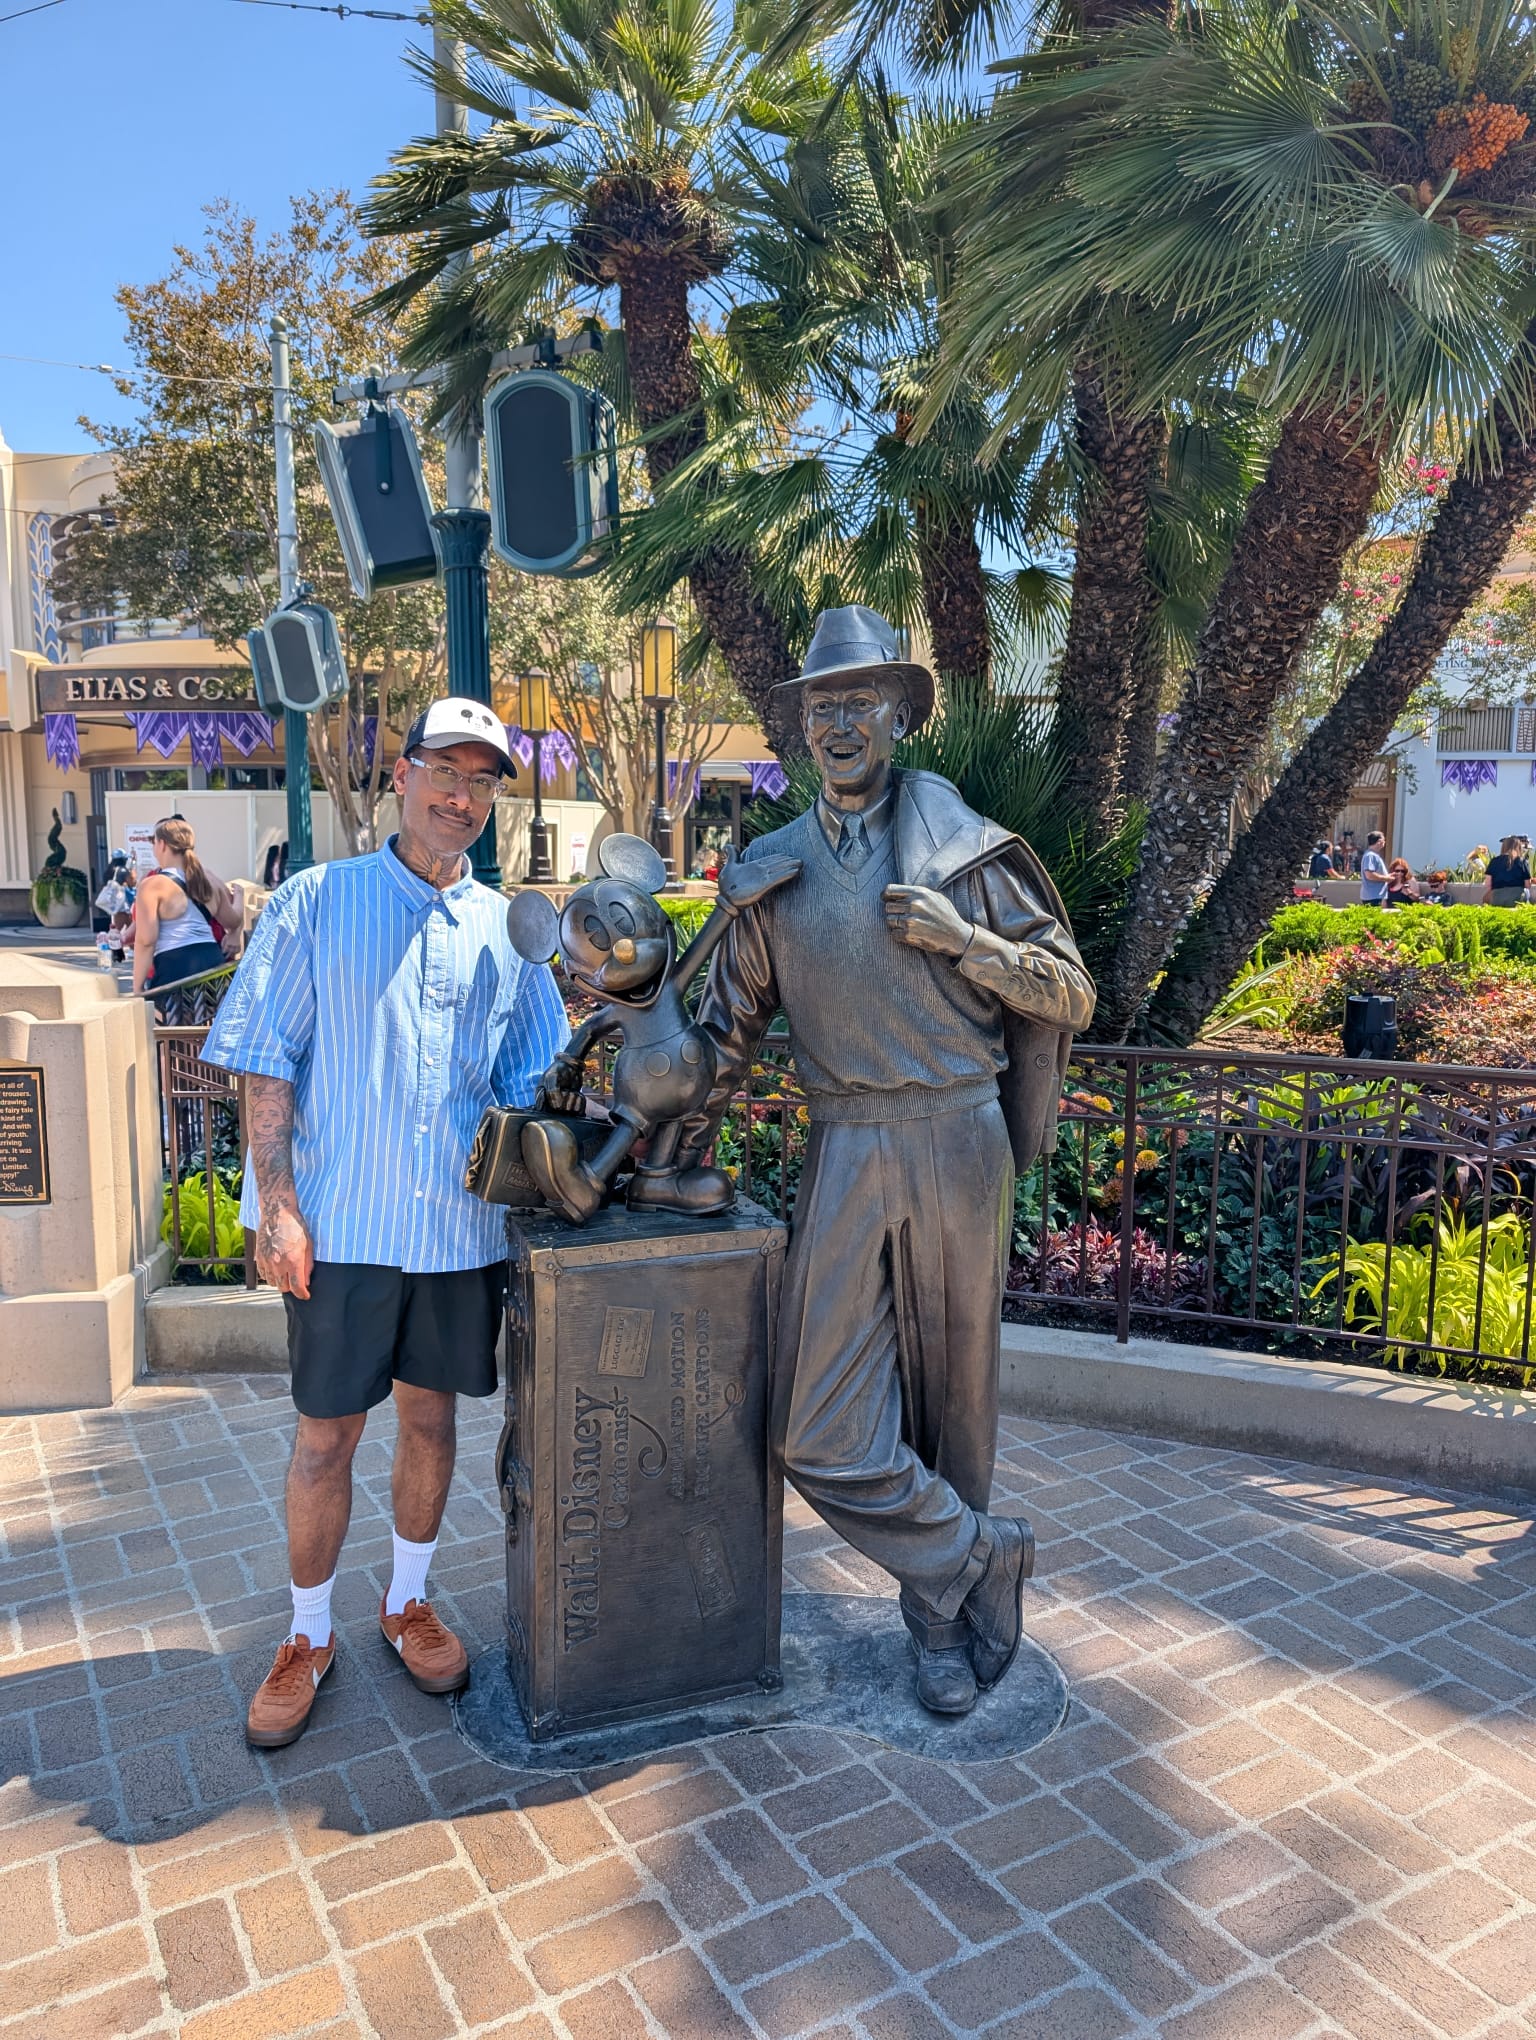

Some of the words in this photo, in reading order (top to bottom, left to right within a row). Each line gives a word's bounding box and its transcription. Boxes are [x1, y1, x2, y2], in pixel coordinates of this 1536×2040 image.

[65, 676, 147, 701] ELIAS
[152, 678, 174, 698] &
[8, 1131, 29, 1139] youth.
[611, 1335, 623, 1370] LUGGAGE
[670, 1311, 686, 1389] MOTION
[694, 1307, 711, 1406] CARTOONS
[561, 1387, 617, 1546] Disney
[602, 1382, 632, 1531] Cartoonist
[670, 1395, 686, 1500] ANIMATED
